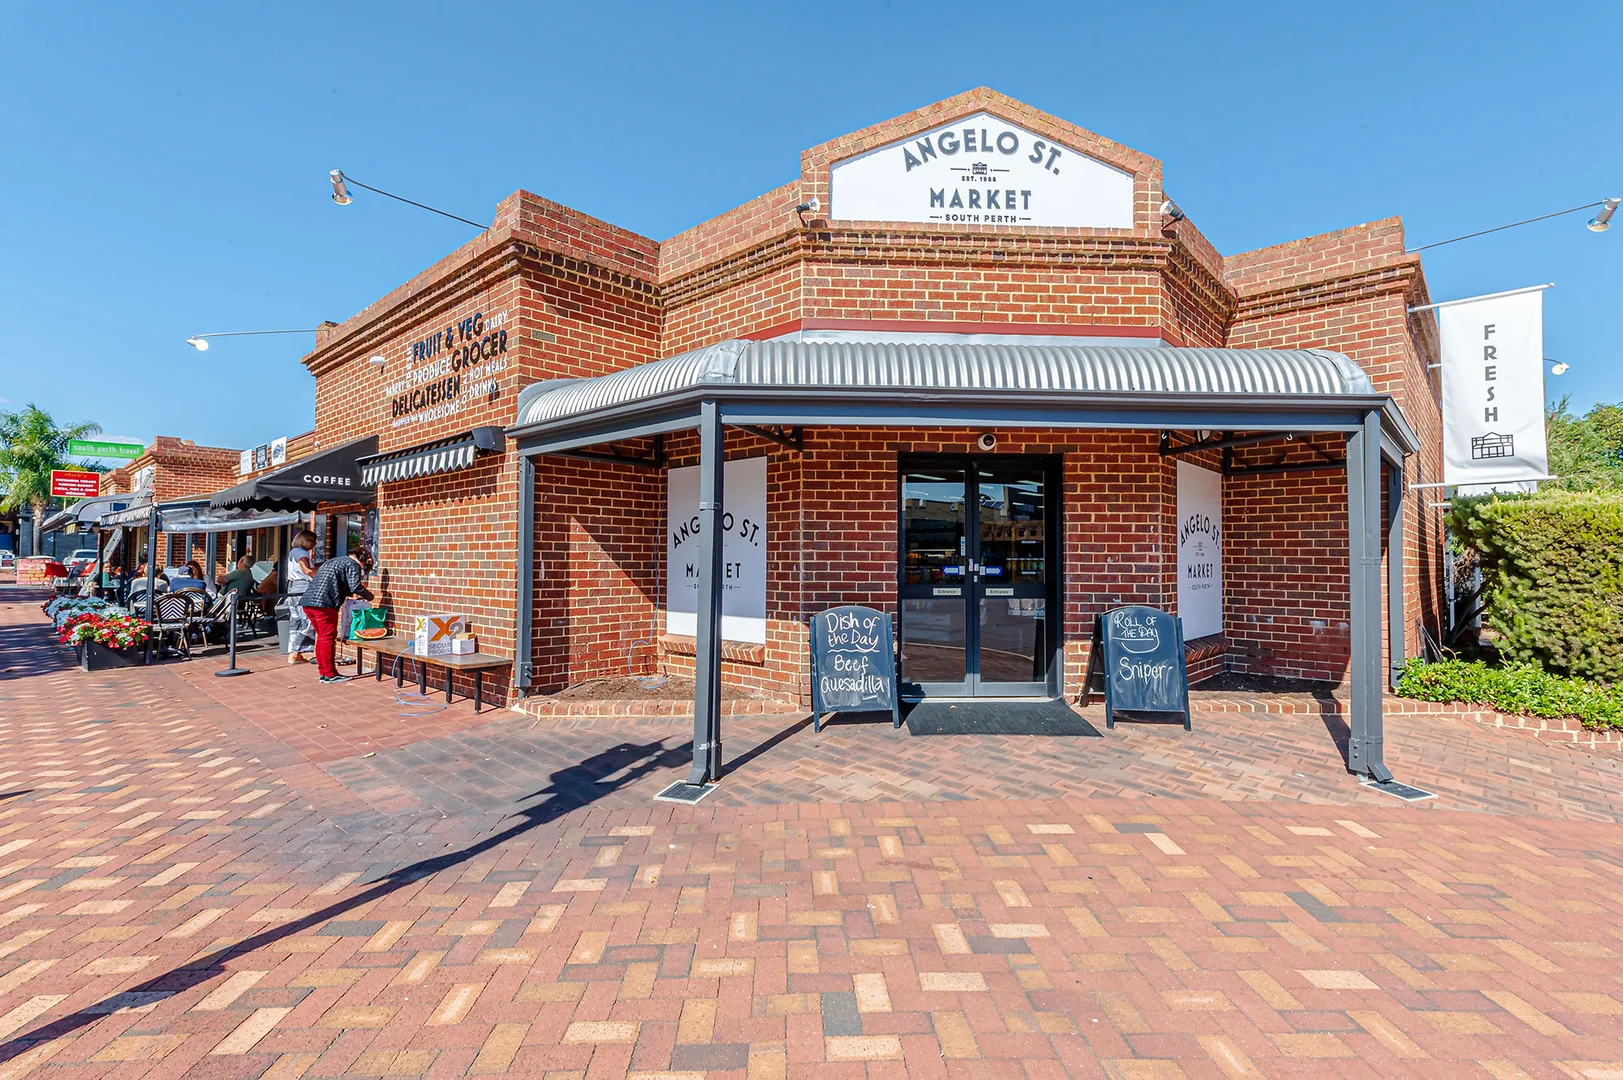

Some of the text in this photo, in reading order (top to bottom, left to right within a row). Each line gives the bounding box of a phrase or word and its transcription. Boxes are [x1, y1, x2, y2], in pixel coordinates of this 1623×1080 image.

[903, 128, 1062, 176] ANGELO ST.
[930, 187, 1032, 210] MARKET
[945, 213, 1017, 223] SOUTH PERTH
[485, 310, 509, 332] DAIRY
[413, 312, 484, 364] FRUIT & VEG
[451, 329, 508, 372] GROCER
[413, 357, 451, 384] PRODUCE
[469, 356, 508, 380] HOT MEALS
[1483, 323, 1499, 423] FRESH
[392, 375, 461, 418] DELICATESSEN
[469, 377, 497, 399] DRINKS
[418, 400, 460, 423] WHOLESOME
[73, 444, 140, 455] south perth travel
[303, 474, 351, 486] COFFEE
[673, 512, 760, 550] ANGO ST.
[1180, 513, 1220, 550] ANGELO ST.
[685, 562, 741, 578] MET
[1187, 563, 1213, 578] MARKET
[825, 611, 881, 636] Dish of
[827, 628, 879, 651] the Day
[833, 654, 869, 674] Beef
[1119, 656, 1167, 685] Sniper
[820, 674, 885, 693] Quesadilla
